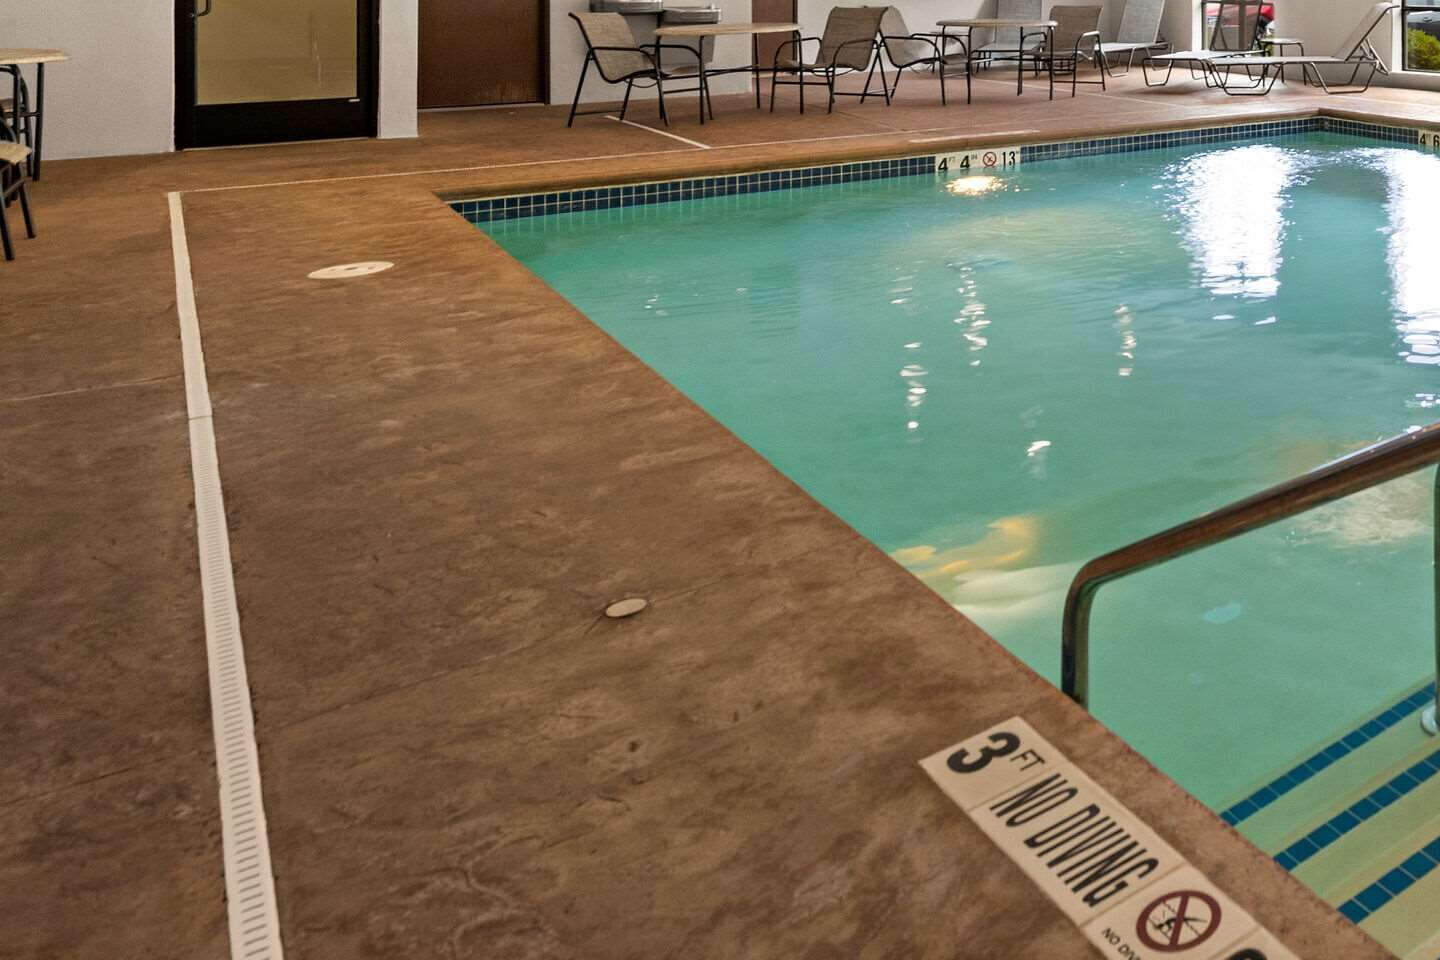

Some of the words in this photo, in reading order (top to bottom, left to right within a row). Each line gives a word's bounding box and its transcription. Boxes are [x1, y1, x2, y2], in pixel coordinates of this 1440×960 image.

[938, 158, 948, 171] 4
[960, 155, 970, 169] 4
[946, 731, 1021, 774] 3
[1009, 748, 1045, 772] FT
[989, 773, 1078, 827] NO
[1023, 803, 1159, 907] DIVING
[1101, 927, 1121, 945] NO
